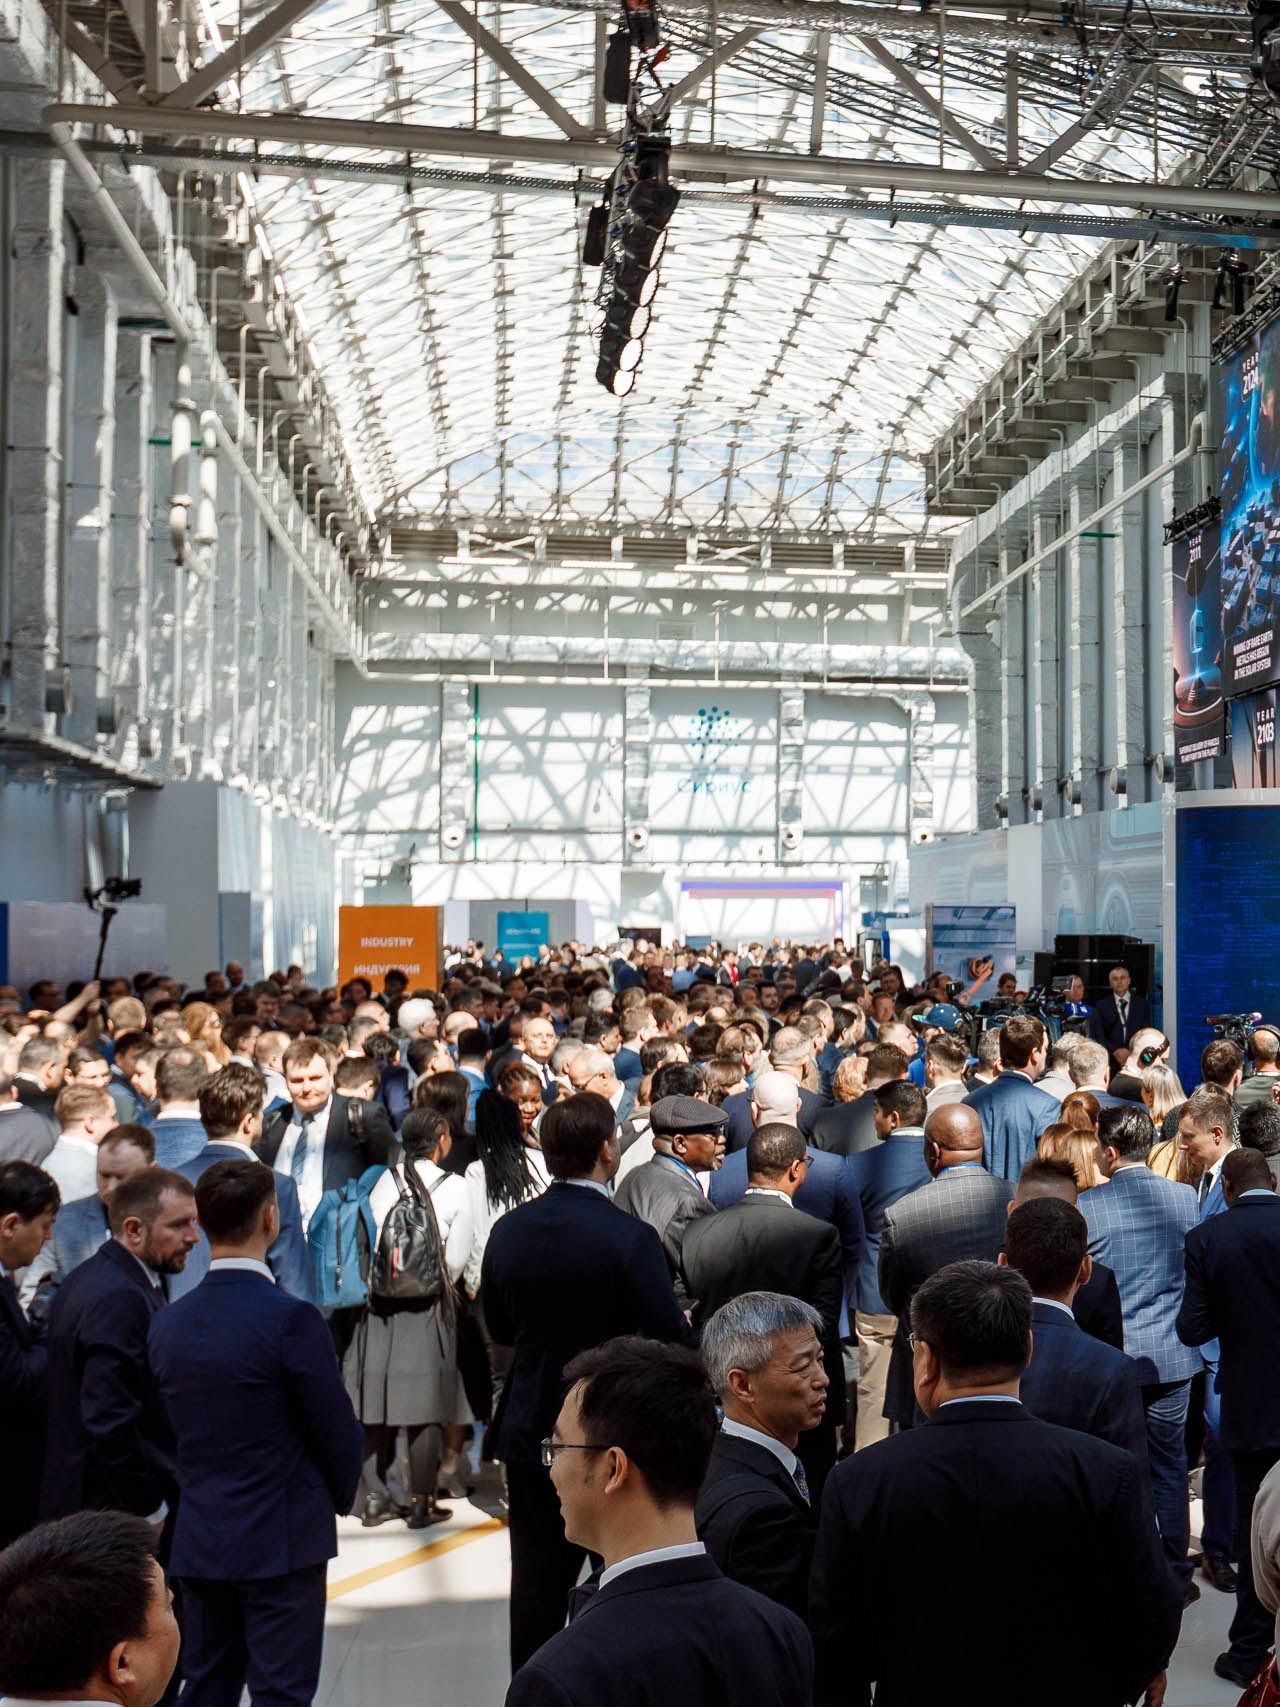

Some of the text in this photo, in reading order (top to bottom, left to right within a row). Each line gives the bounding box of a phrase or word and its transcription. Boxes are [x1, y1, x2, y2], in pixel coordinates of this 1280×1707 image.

[1256, 707, 1275, 722] YEAR
[1257, 722, 1275, 744] 2103
[361, 936, 414, 948] INDUSTRY
